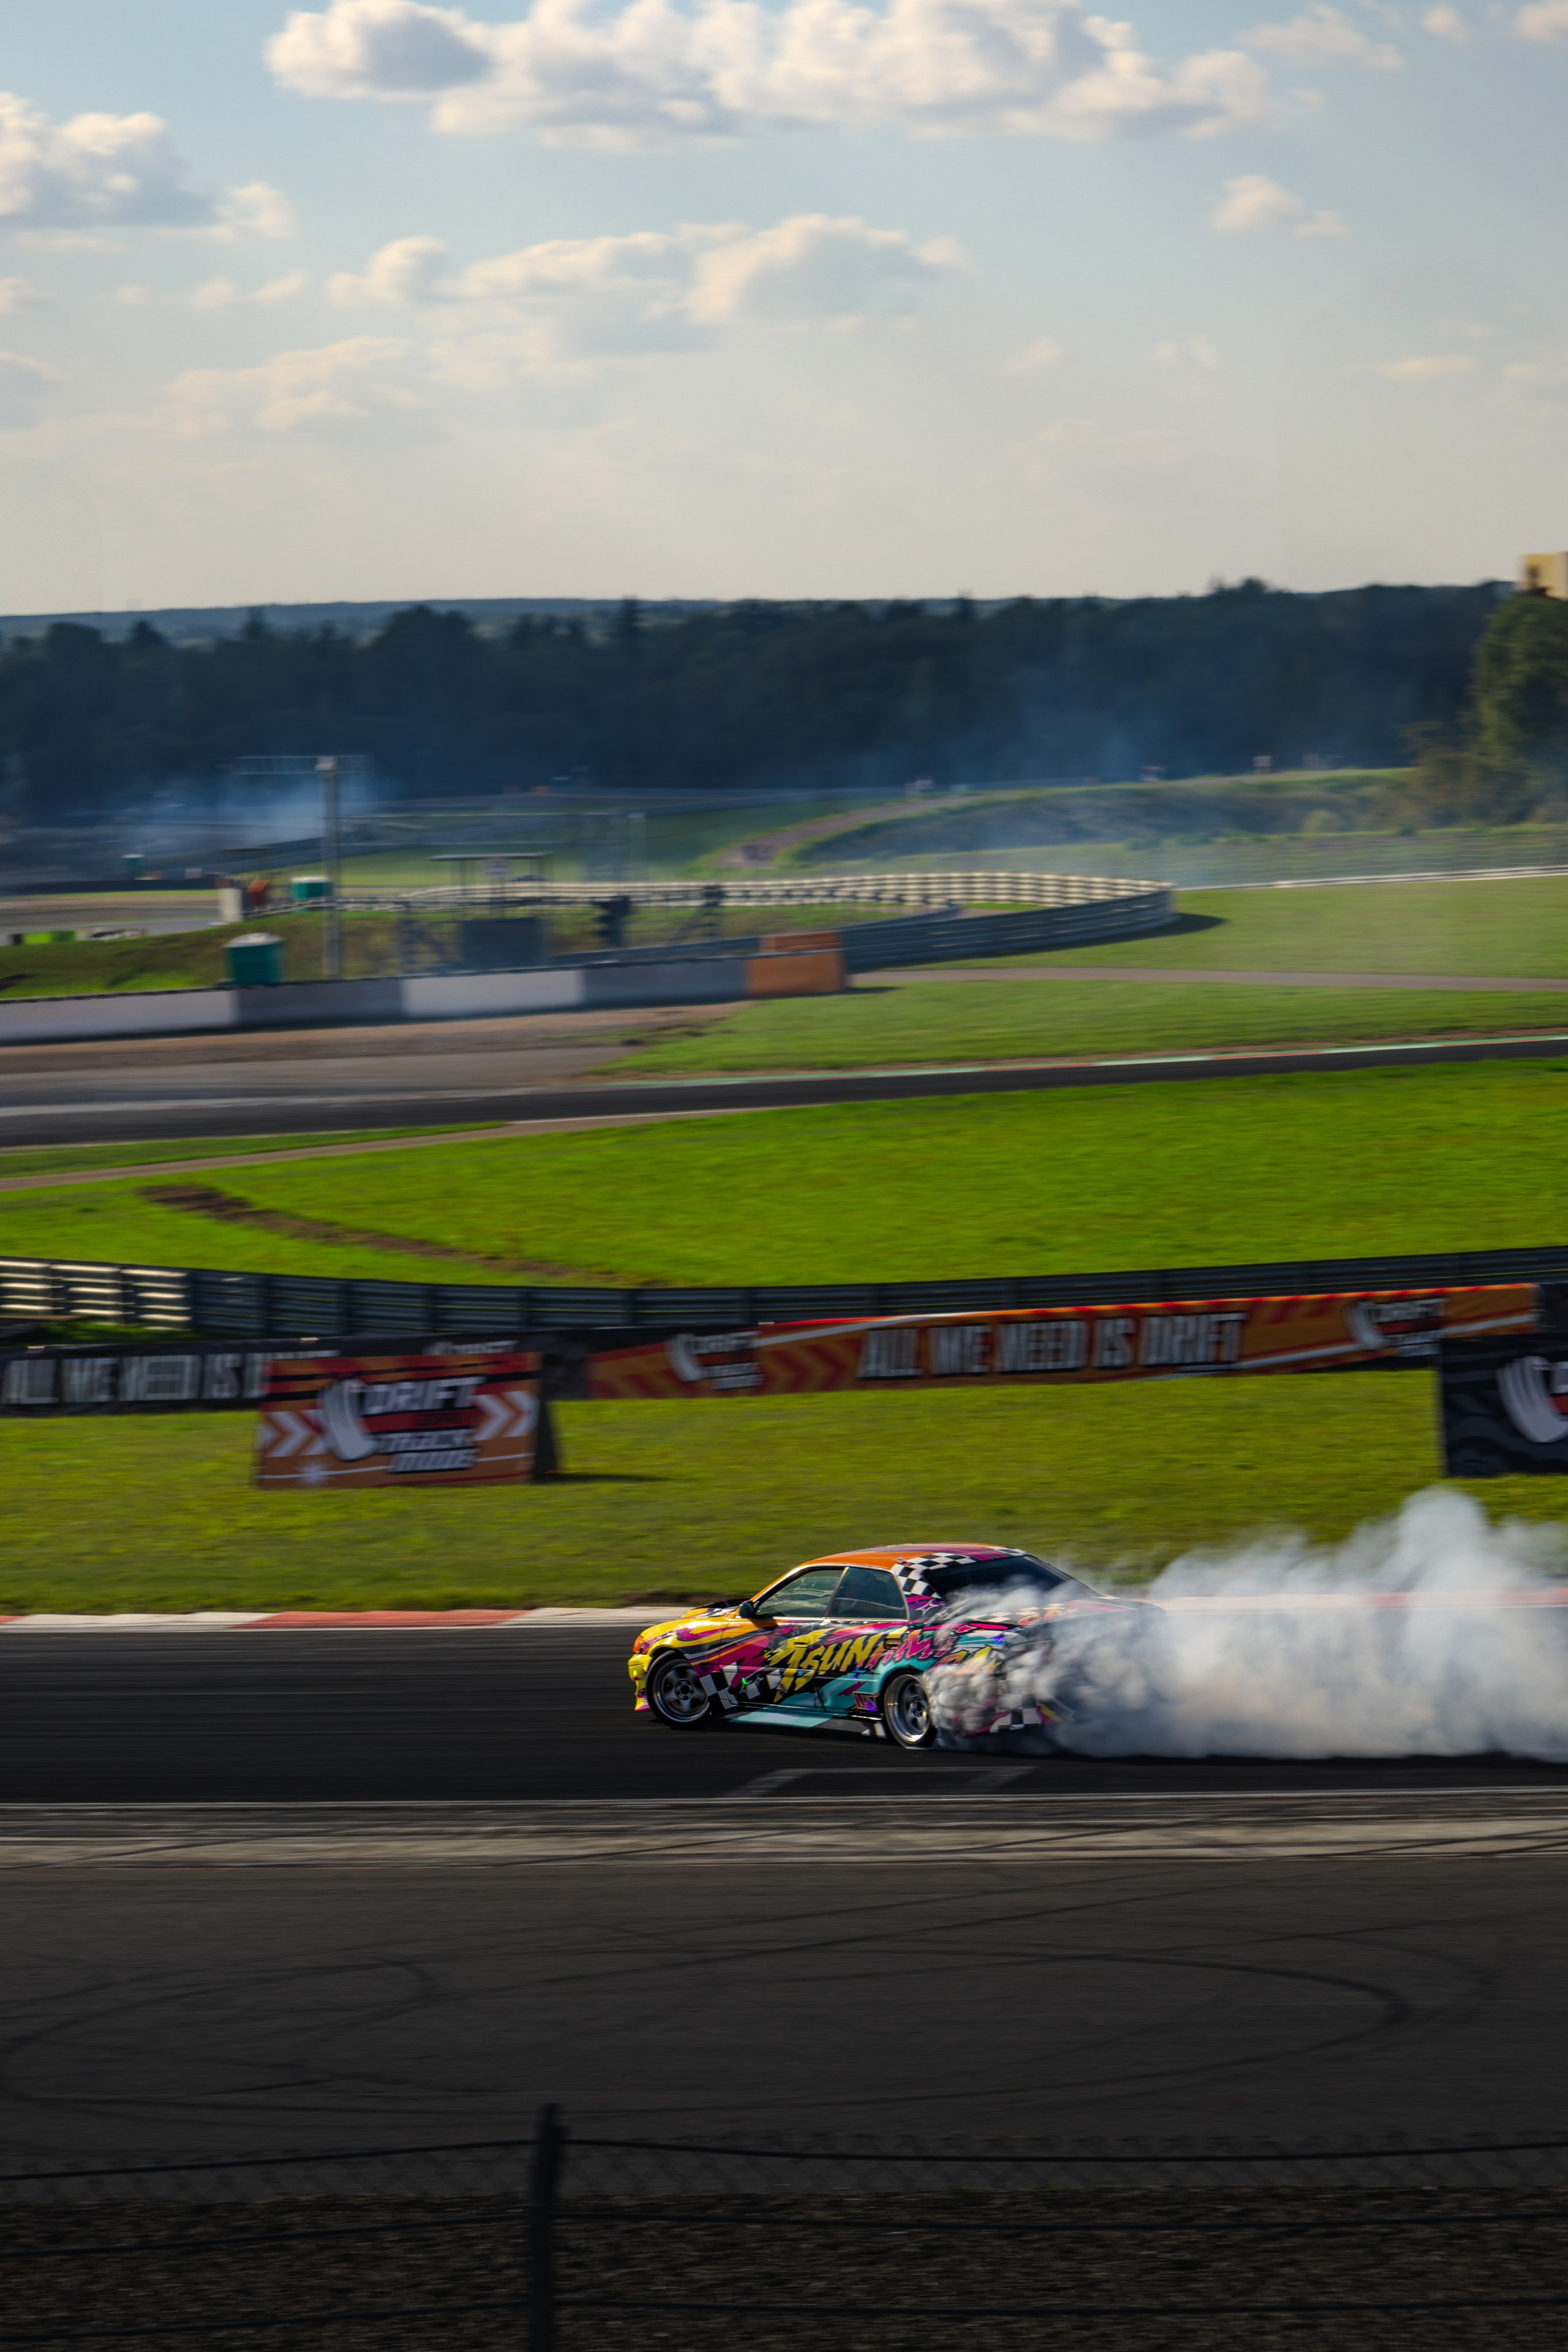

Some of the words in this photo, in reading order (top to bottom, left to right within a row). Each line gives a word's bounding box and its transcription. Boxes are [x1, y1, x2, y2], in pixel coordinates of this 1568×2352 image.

[860, 1328, 922, 1378] ALL
[929, 1325, 990, 1374] WE
[997, 1320, 1084, 1372] NEED
[1095, 1317, 1131, 1367] IS
[1141, 1312, 1246, 1366] DRIFT
[365, 1376, 485, 1415] DRIFT
